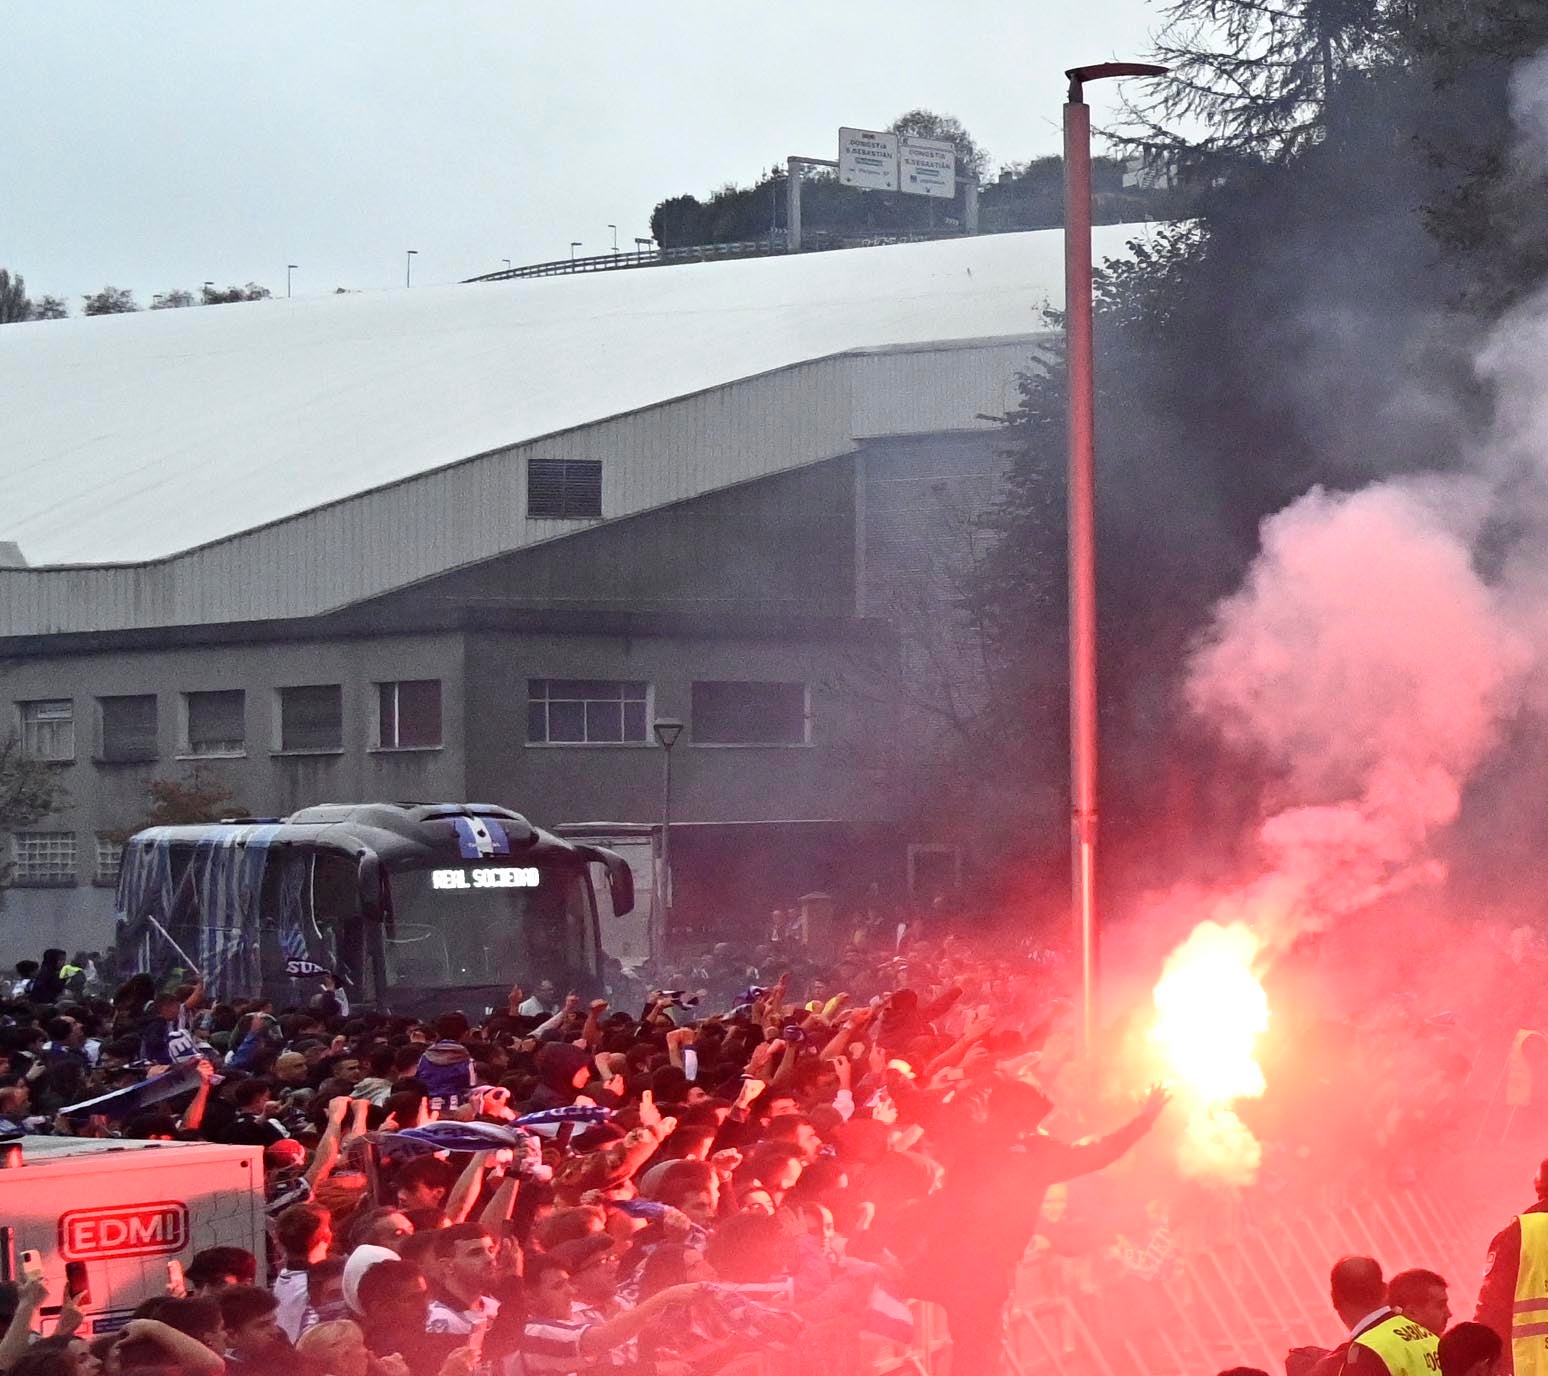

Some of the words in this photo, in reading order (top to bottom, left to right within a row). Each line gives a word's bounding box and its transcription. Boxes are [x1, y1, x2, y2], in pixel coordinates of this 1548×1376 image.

[432, 869, 471, 889] REAL
[472, 867, 540, 888] SOCIEDAD
[74, 1211, 175, 1250] EDMI
